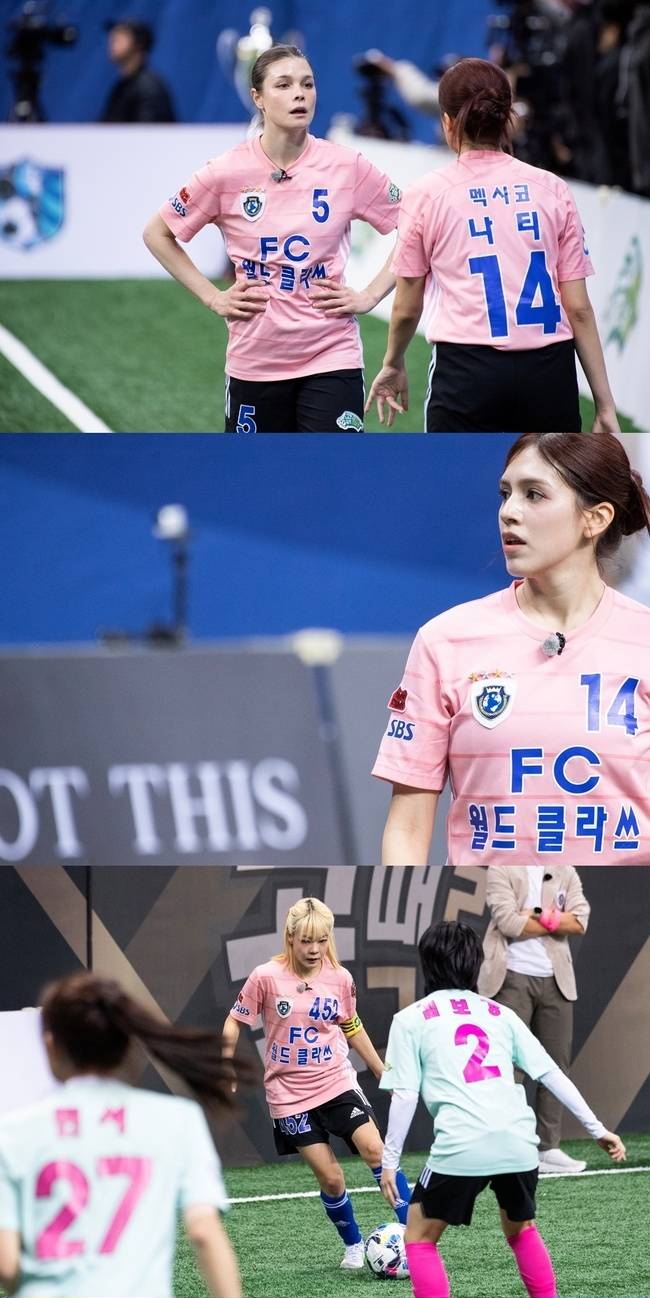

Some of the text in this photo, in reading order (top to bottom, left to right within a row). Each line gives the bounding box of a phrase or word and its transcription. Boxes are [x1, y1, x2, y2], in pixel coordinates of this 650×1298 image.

[171, 197, 187, 217] SBS
[312, 188, 330, 223] 5
[469, 184, 530, 206] 멕시코
[260, 235, 310, 262] FC
[468, 250, 562, 337] 14
[237, 405, 257, 433] 5
[580, 674, 639, 736] 14
[387, 719, 416, 741] SBS
[511, 747, 601, 794] FC
[107, 757, 308, 856] THIS
[469, 804, 640, 852] 월드 클라쓰
[309, 997, 338, 1020] 452
[290, 1026, 319, 1044] FC
[298, 1044, 332, 1065] 클라쓰
[454, 1023, 501, 1083] 2
[35, 1158, 151, 1260] 27
